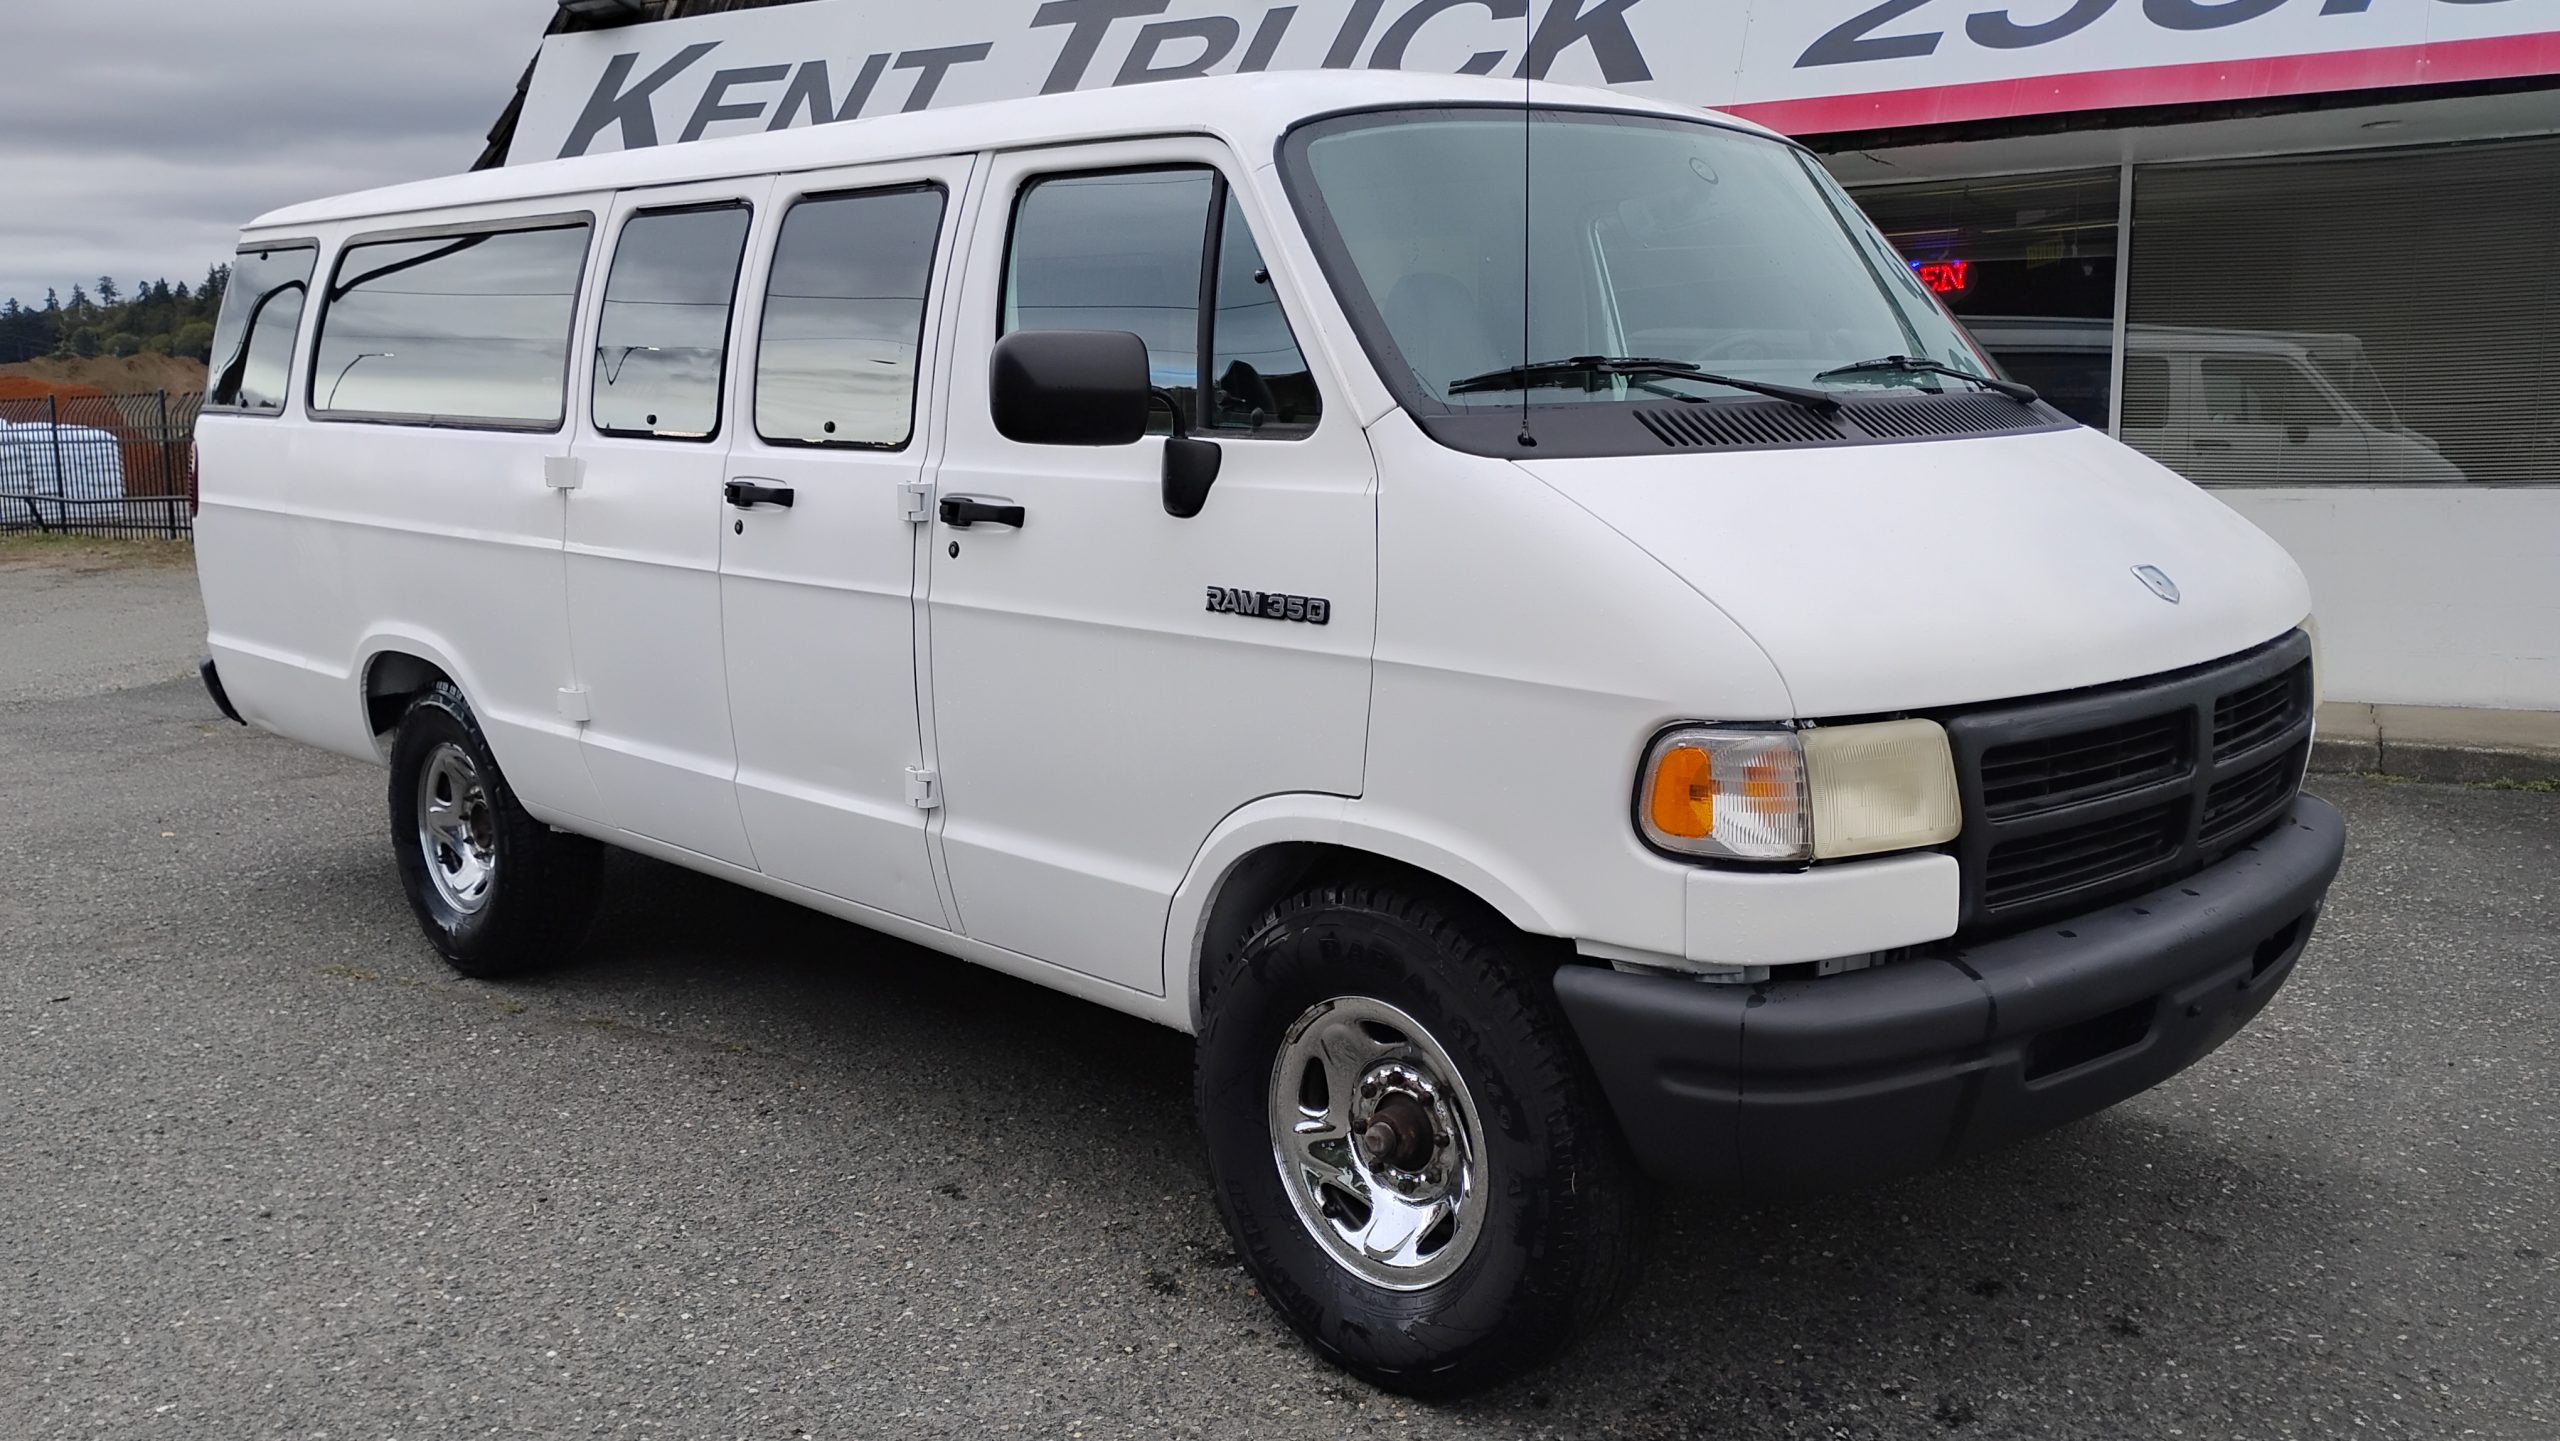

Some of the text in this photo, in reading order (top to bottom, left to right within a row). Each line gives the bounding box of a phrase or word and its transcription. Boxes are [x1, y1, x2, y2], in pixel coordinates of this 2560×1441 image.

[556, 0, 1653, 159] KENT TRUCK
[1919, 262, 1967, 292] EN
[1205, 586, 1331, 625] RAM 350
